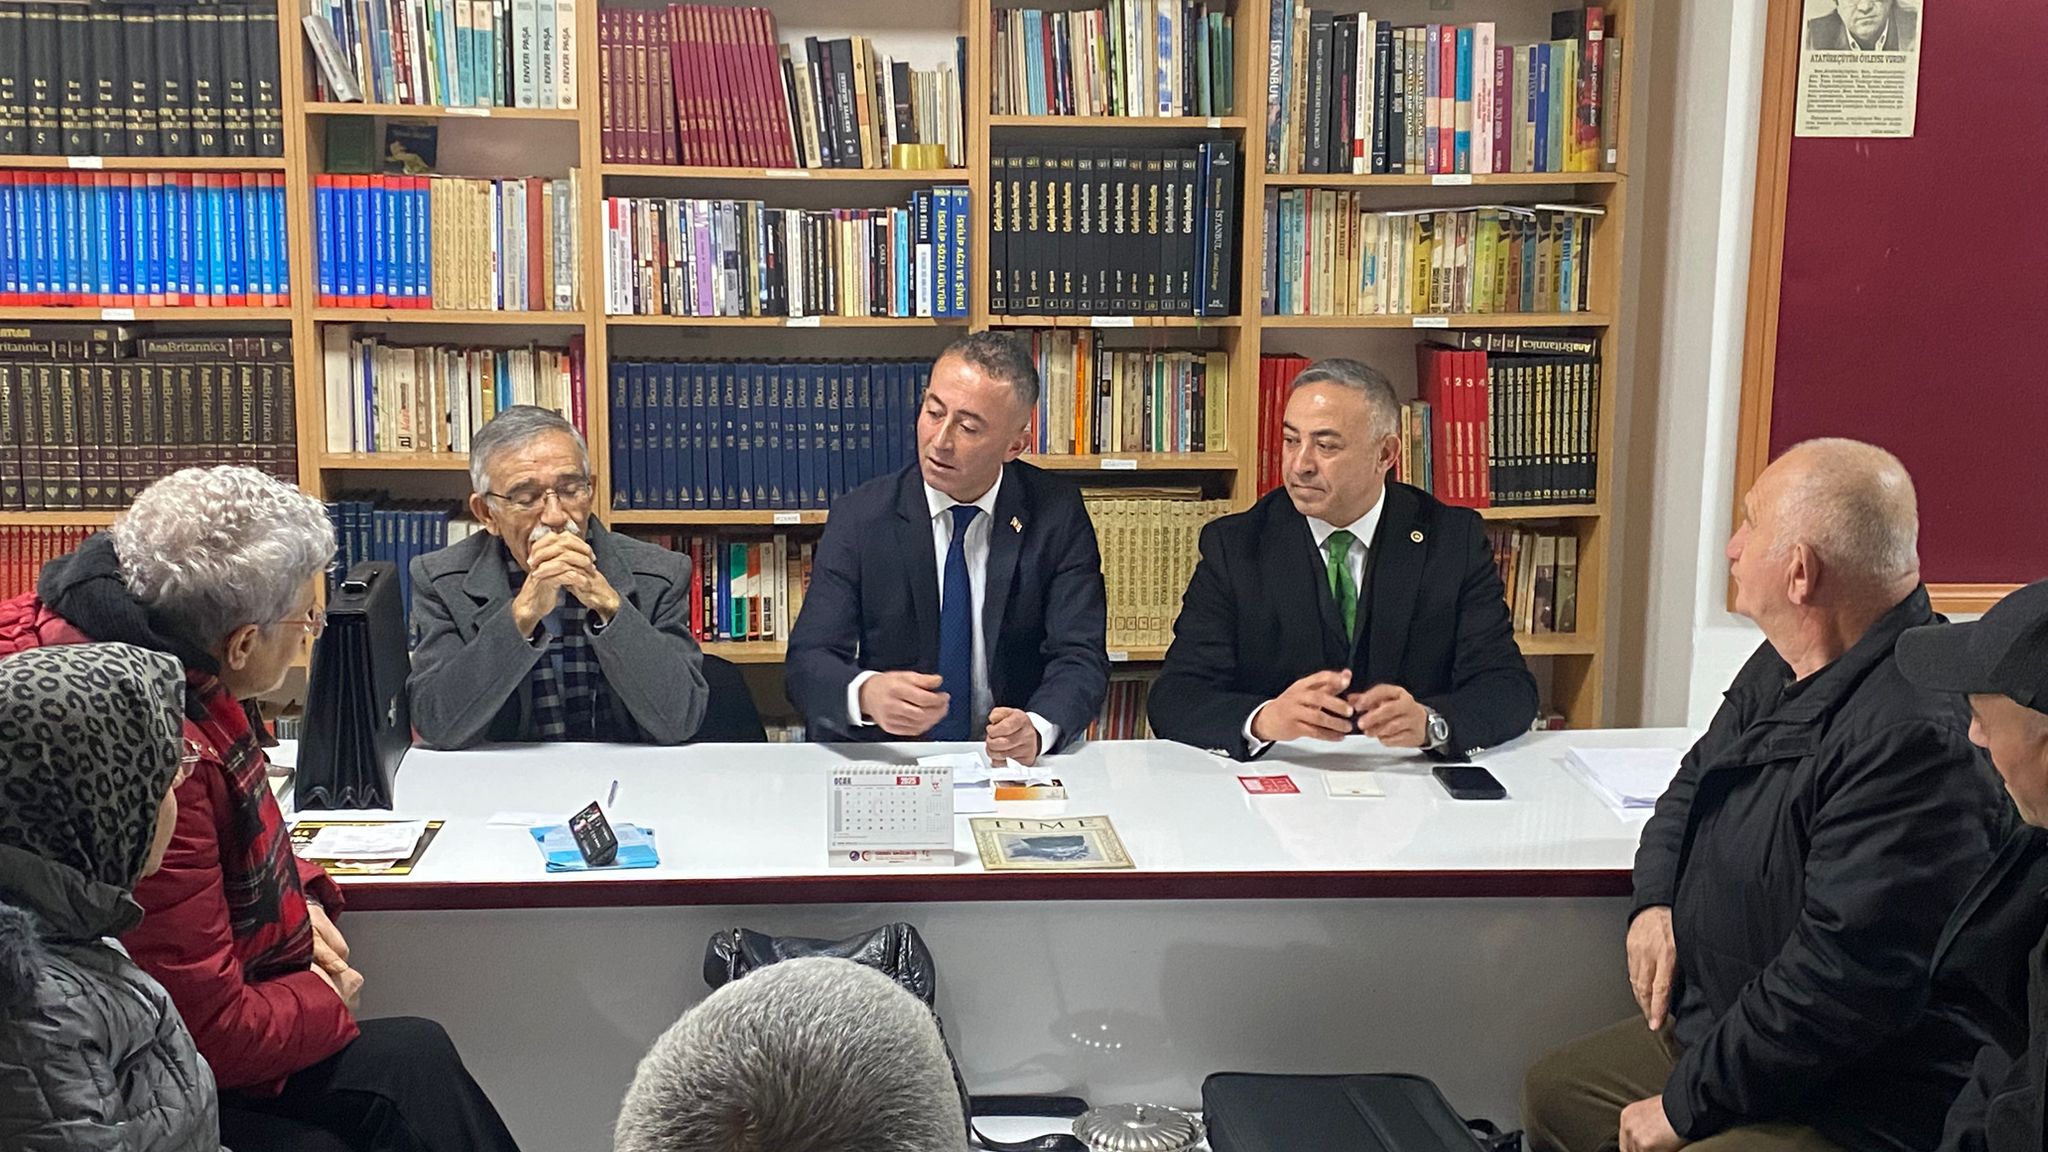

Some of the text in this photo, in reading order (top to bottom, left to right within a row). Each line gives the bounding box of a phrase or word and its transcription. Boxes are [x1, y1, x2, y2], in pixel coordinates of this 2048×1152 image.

[1430, 31, 1437, 42] 3
[1443, 32, 1451, 43] 2
[522, 26, 532, 84] ENVER PAŞA
[543, 27, 553, 84] ENVER PAŞA
[562, 27, 571, 84] ENVER PAŞA
[1268, 39, 1282, 102] İSTANBUL
[37, 132, 46, 145] 5
[201, 133, 213, 146] 10
[233, 134, 245, 146] 11
[939, 197, 946, 206] 2
[1214, 210, 1224, 250] İSTANBUL
[937, 210, 948, 312] İSKİLİP SÖZLÜ KÜLTÜRÜ
[955, 214, 967, 310] İSKİLİP AĞZI VE ŞİVESİ
[0, 342, 49, 352] ritannica
[148, 342, 227, 352] AnaBritannica
[1522, 339, 1592, 353] AnaBritannica
[1455, 377, 1462, 386] 2
[1466, 378, 1473, 387] 3
